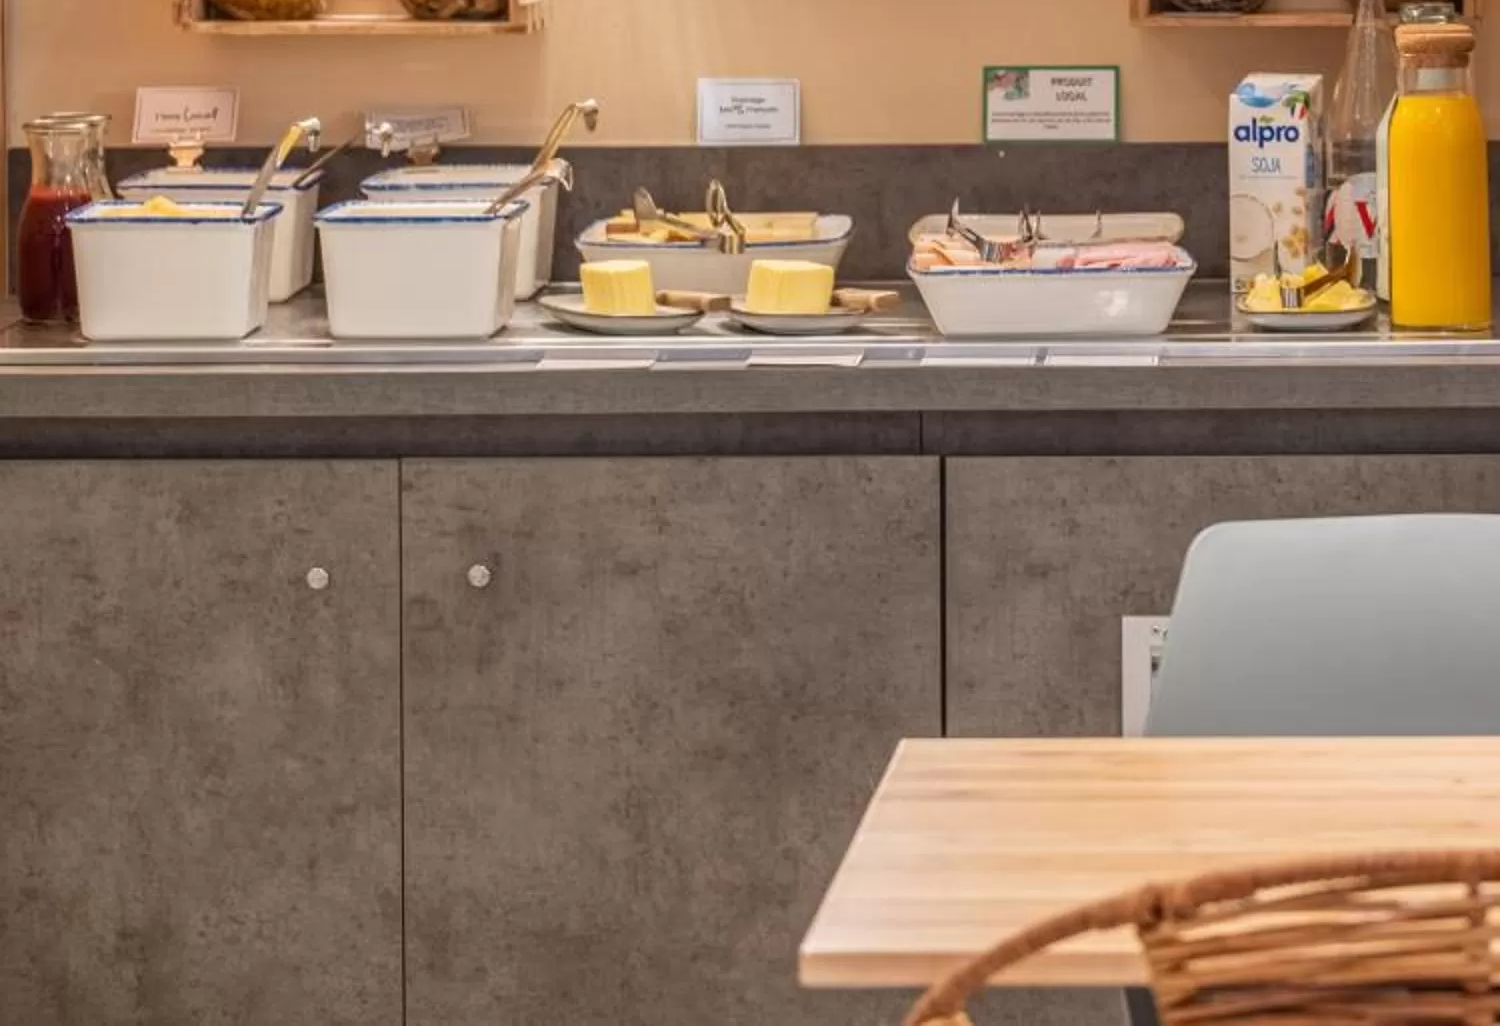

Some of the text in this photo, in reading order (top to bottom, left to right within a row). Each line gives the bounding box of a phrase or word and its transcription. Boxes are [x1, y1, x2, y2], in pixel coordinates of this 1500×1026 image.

[1050, 77, 1094, 87] PRODUIT
[1055, 90, 1088, 102] LOCAL
[1234, 117, 1299, 148] alpro
